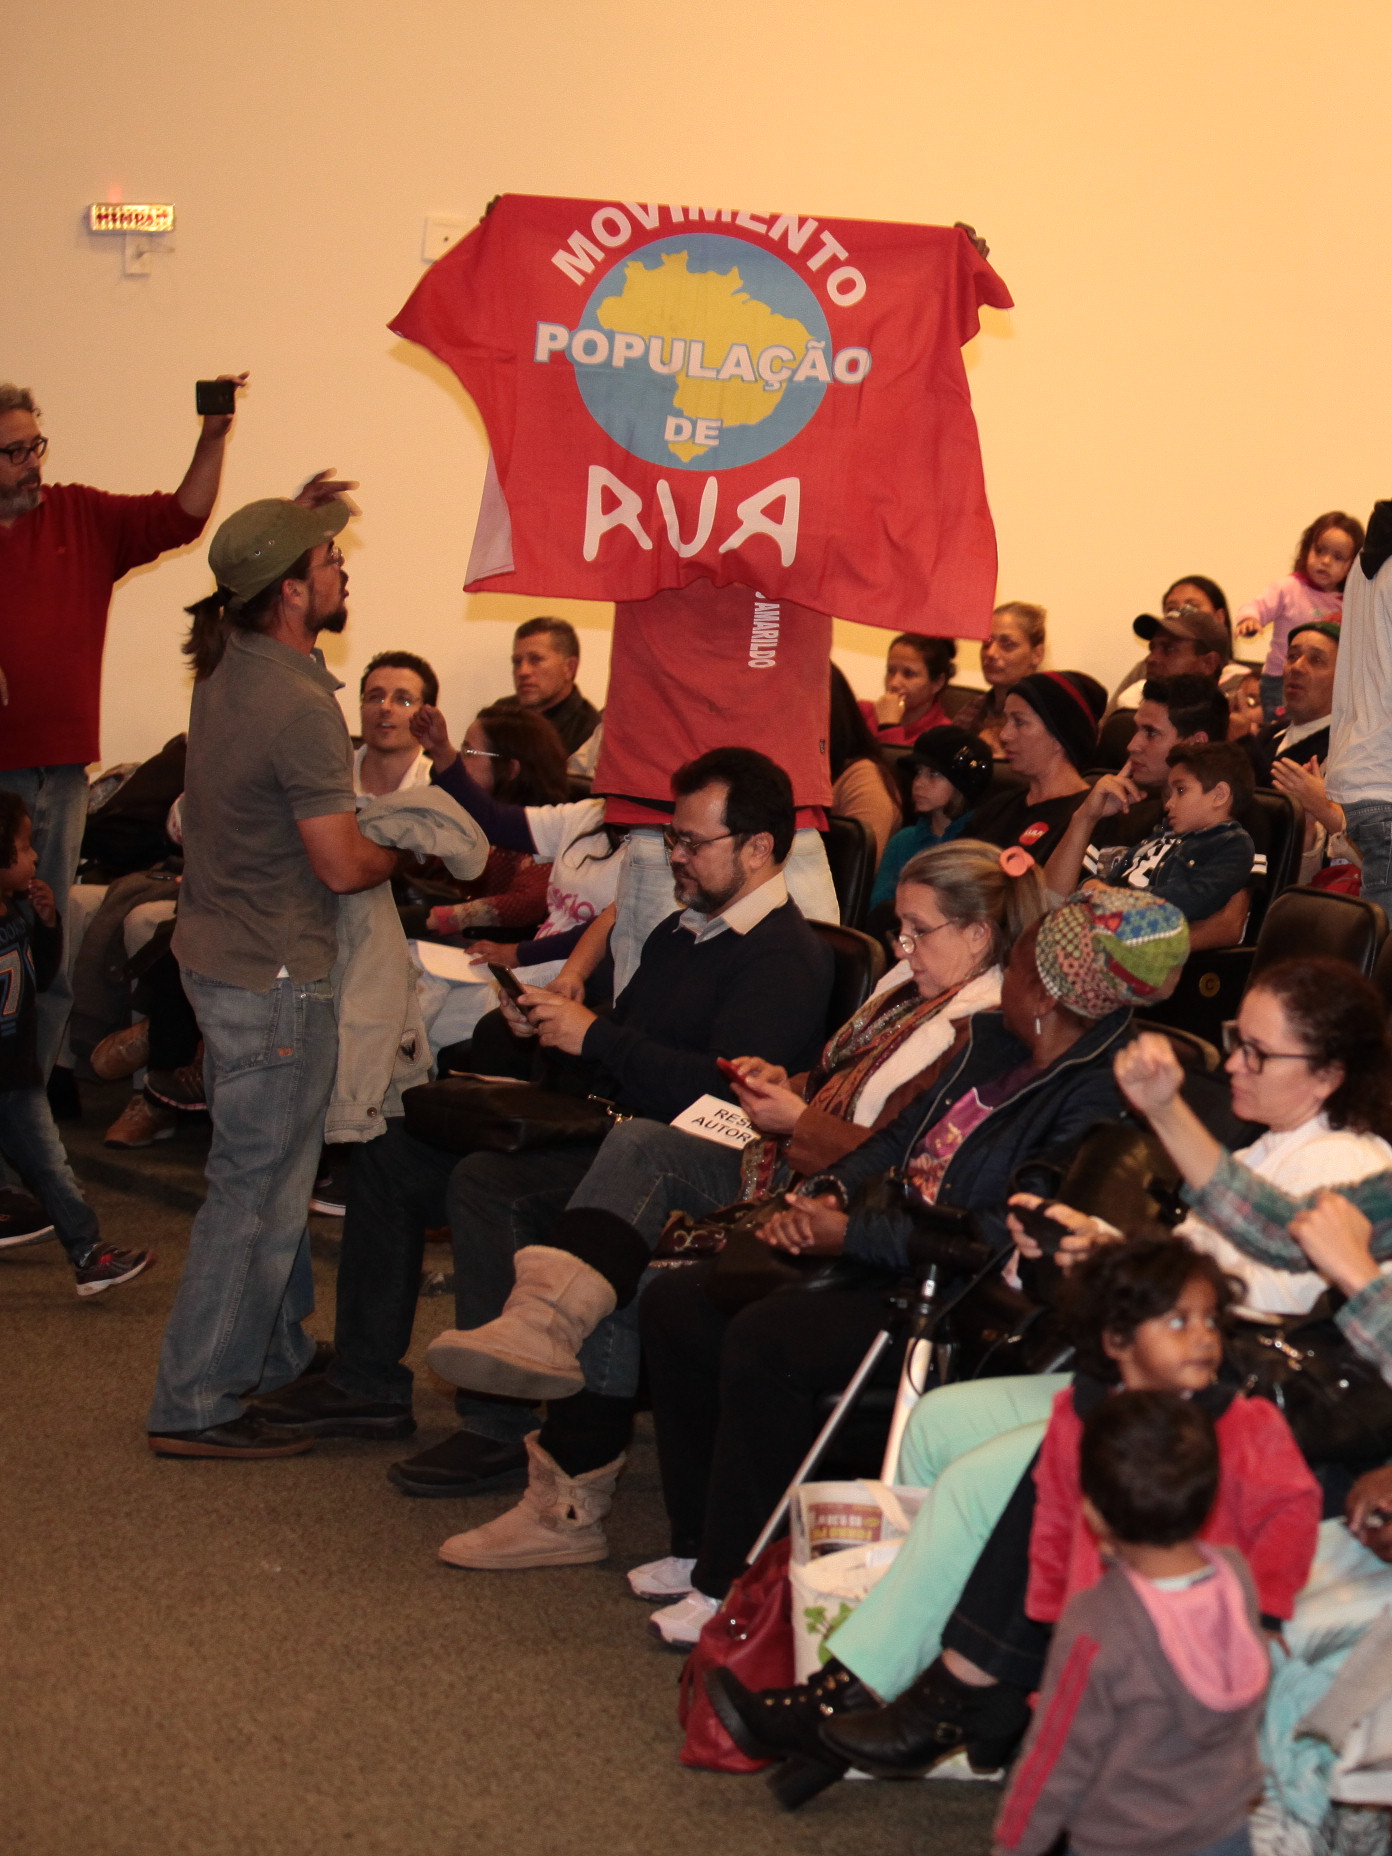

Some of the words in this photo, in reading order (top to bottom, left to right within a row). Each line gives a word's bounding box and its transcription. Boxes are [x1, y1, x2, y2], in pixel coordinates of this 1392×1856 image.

[533, 321, 872, 392] POPULAÇÃO
[663, 414, 722, 447] DE
[583, 464, 801, 568] RUA
[747, 602, 780, 668] AMARILDO
